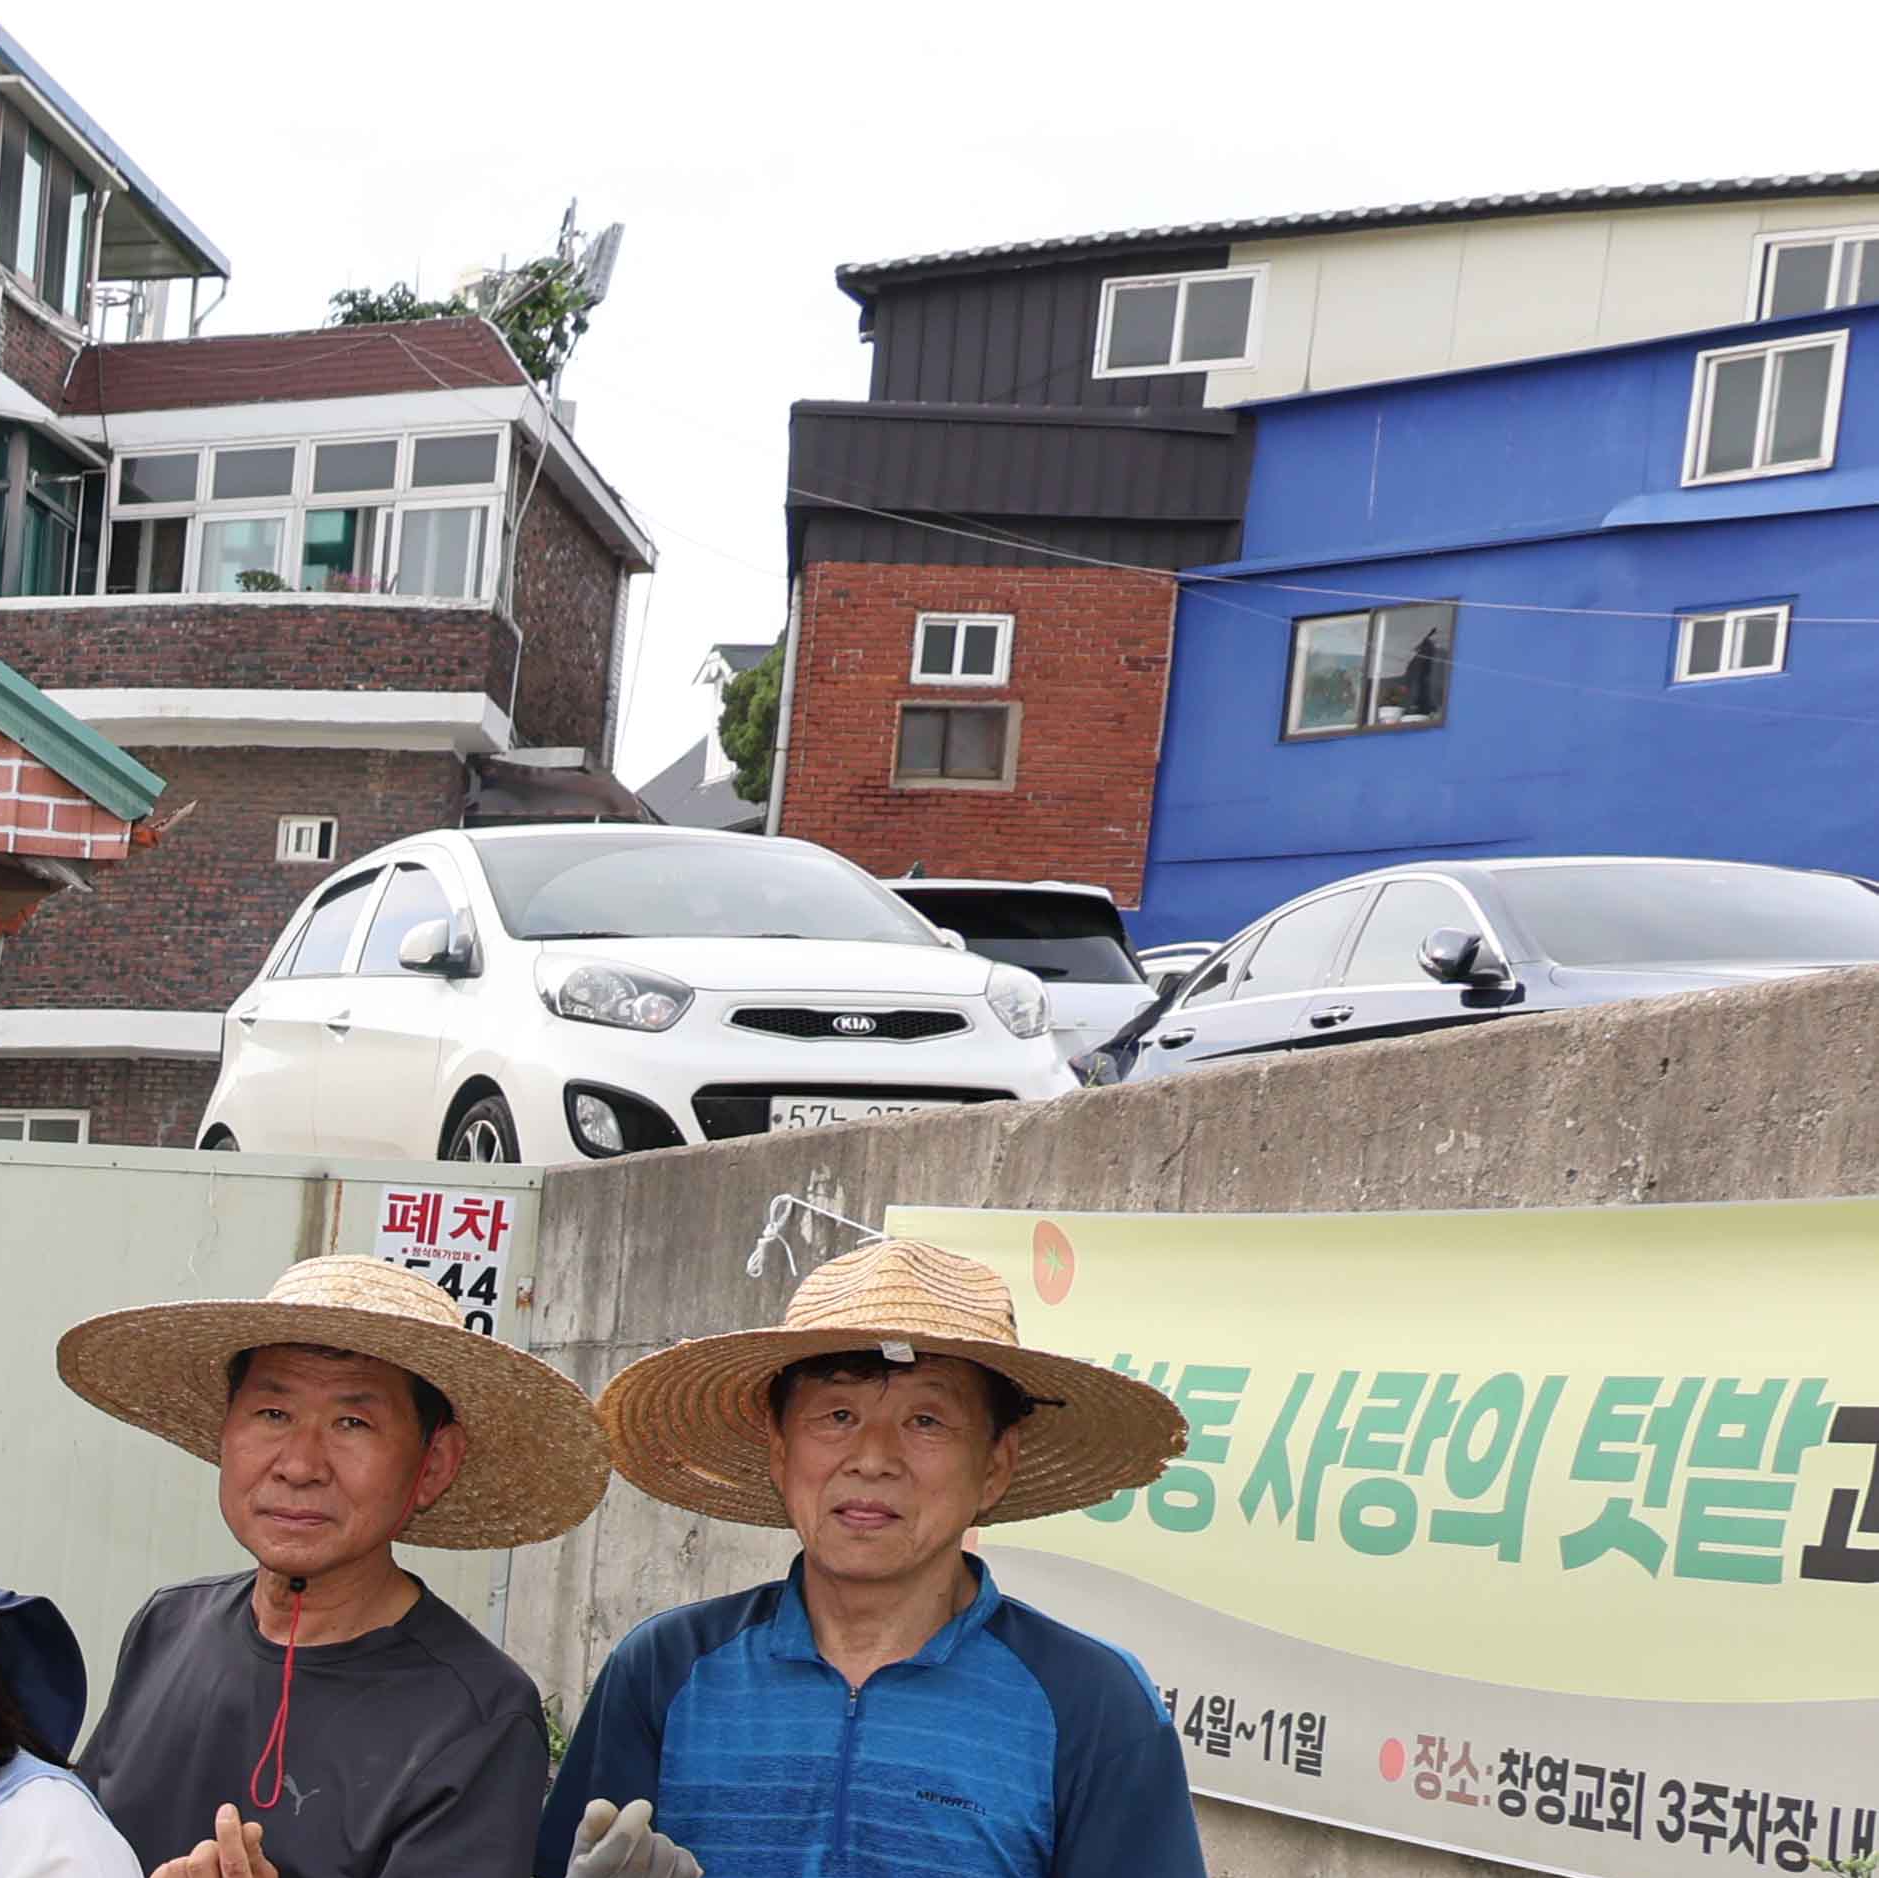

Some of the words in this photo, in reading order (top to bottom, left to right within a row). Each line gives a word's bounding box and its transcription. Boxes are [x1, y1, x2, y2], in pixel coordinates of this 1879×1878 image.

[841, 1016, 871, 1031] KIA
[382, 1192, 509, 1252] 폐차
[383, 1256, 498, 1306] 44
[1238, 1369, 1570, 1564] 사랑의
[1182, 1694, 1327, 1778] 4월~11월
[1656, 1779, 1818, 1874] 3주차장
